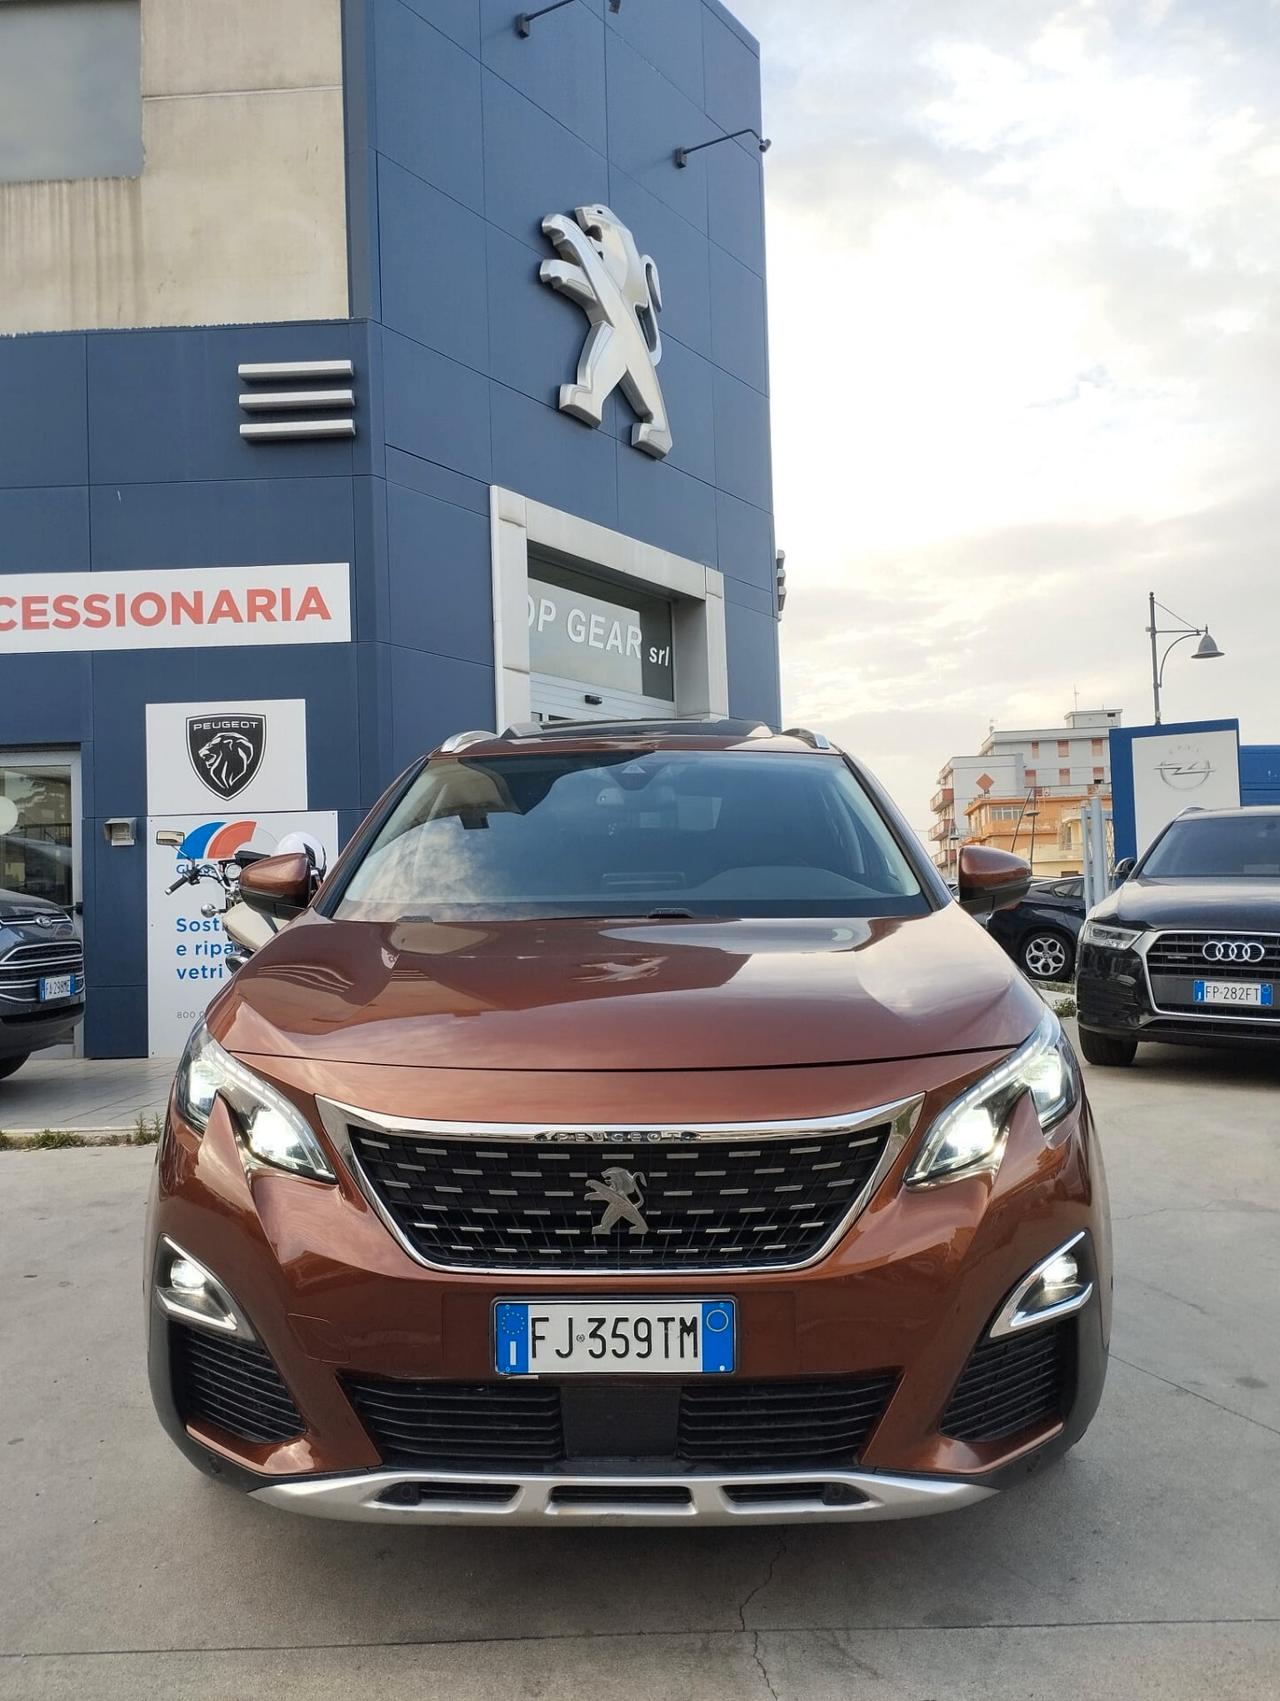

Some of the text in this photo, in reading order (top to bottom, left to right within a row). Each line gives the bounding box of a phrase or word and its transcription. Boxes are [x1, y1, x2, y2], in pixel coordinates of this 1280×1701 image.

[567, 608, 642, 658] GEAR
[649, 646, 669, 666] srl
[193, 721, 258, 731] PEUGEOT
[176, 945, 187, 956] e
[177, 964, 223, 979] vetri
